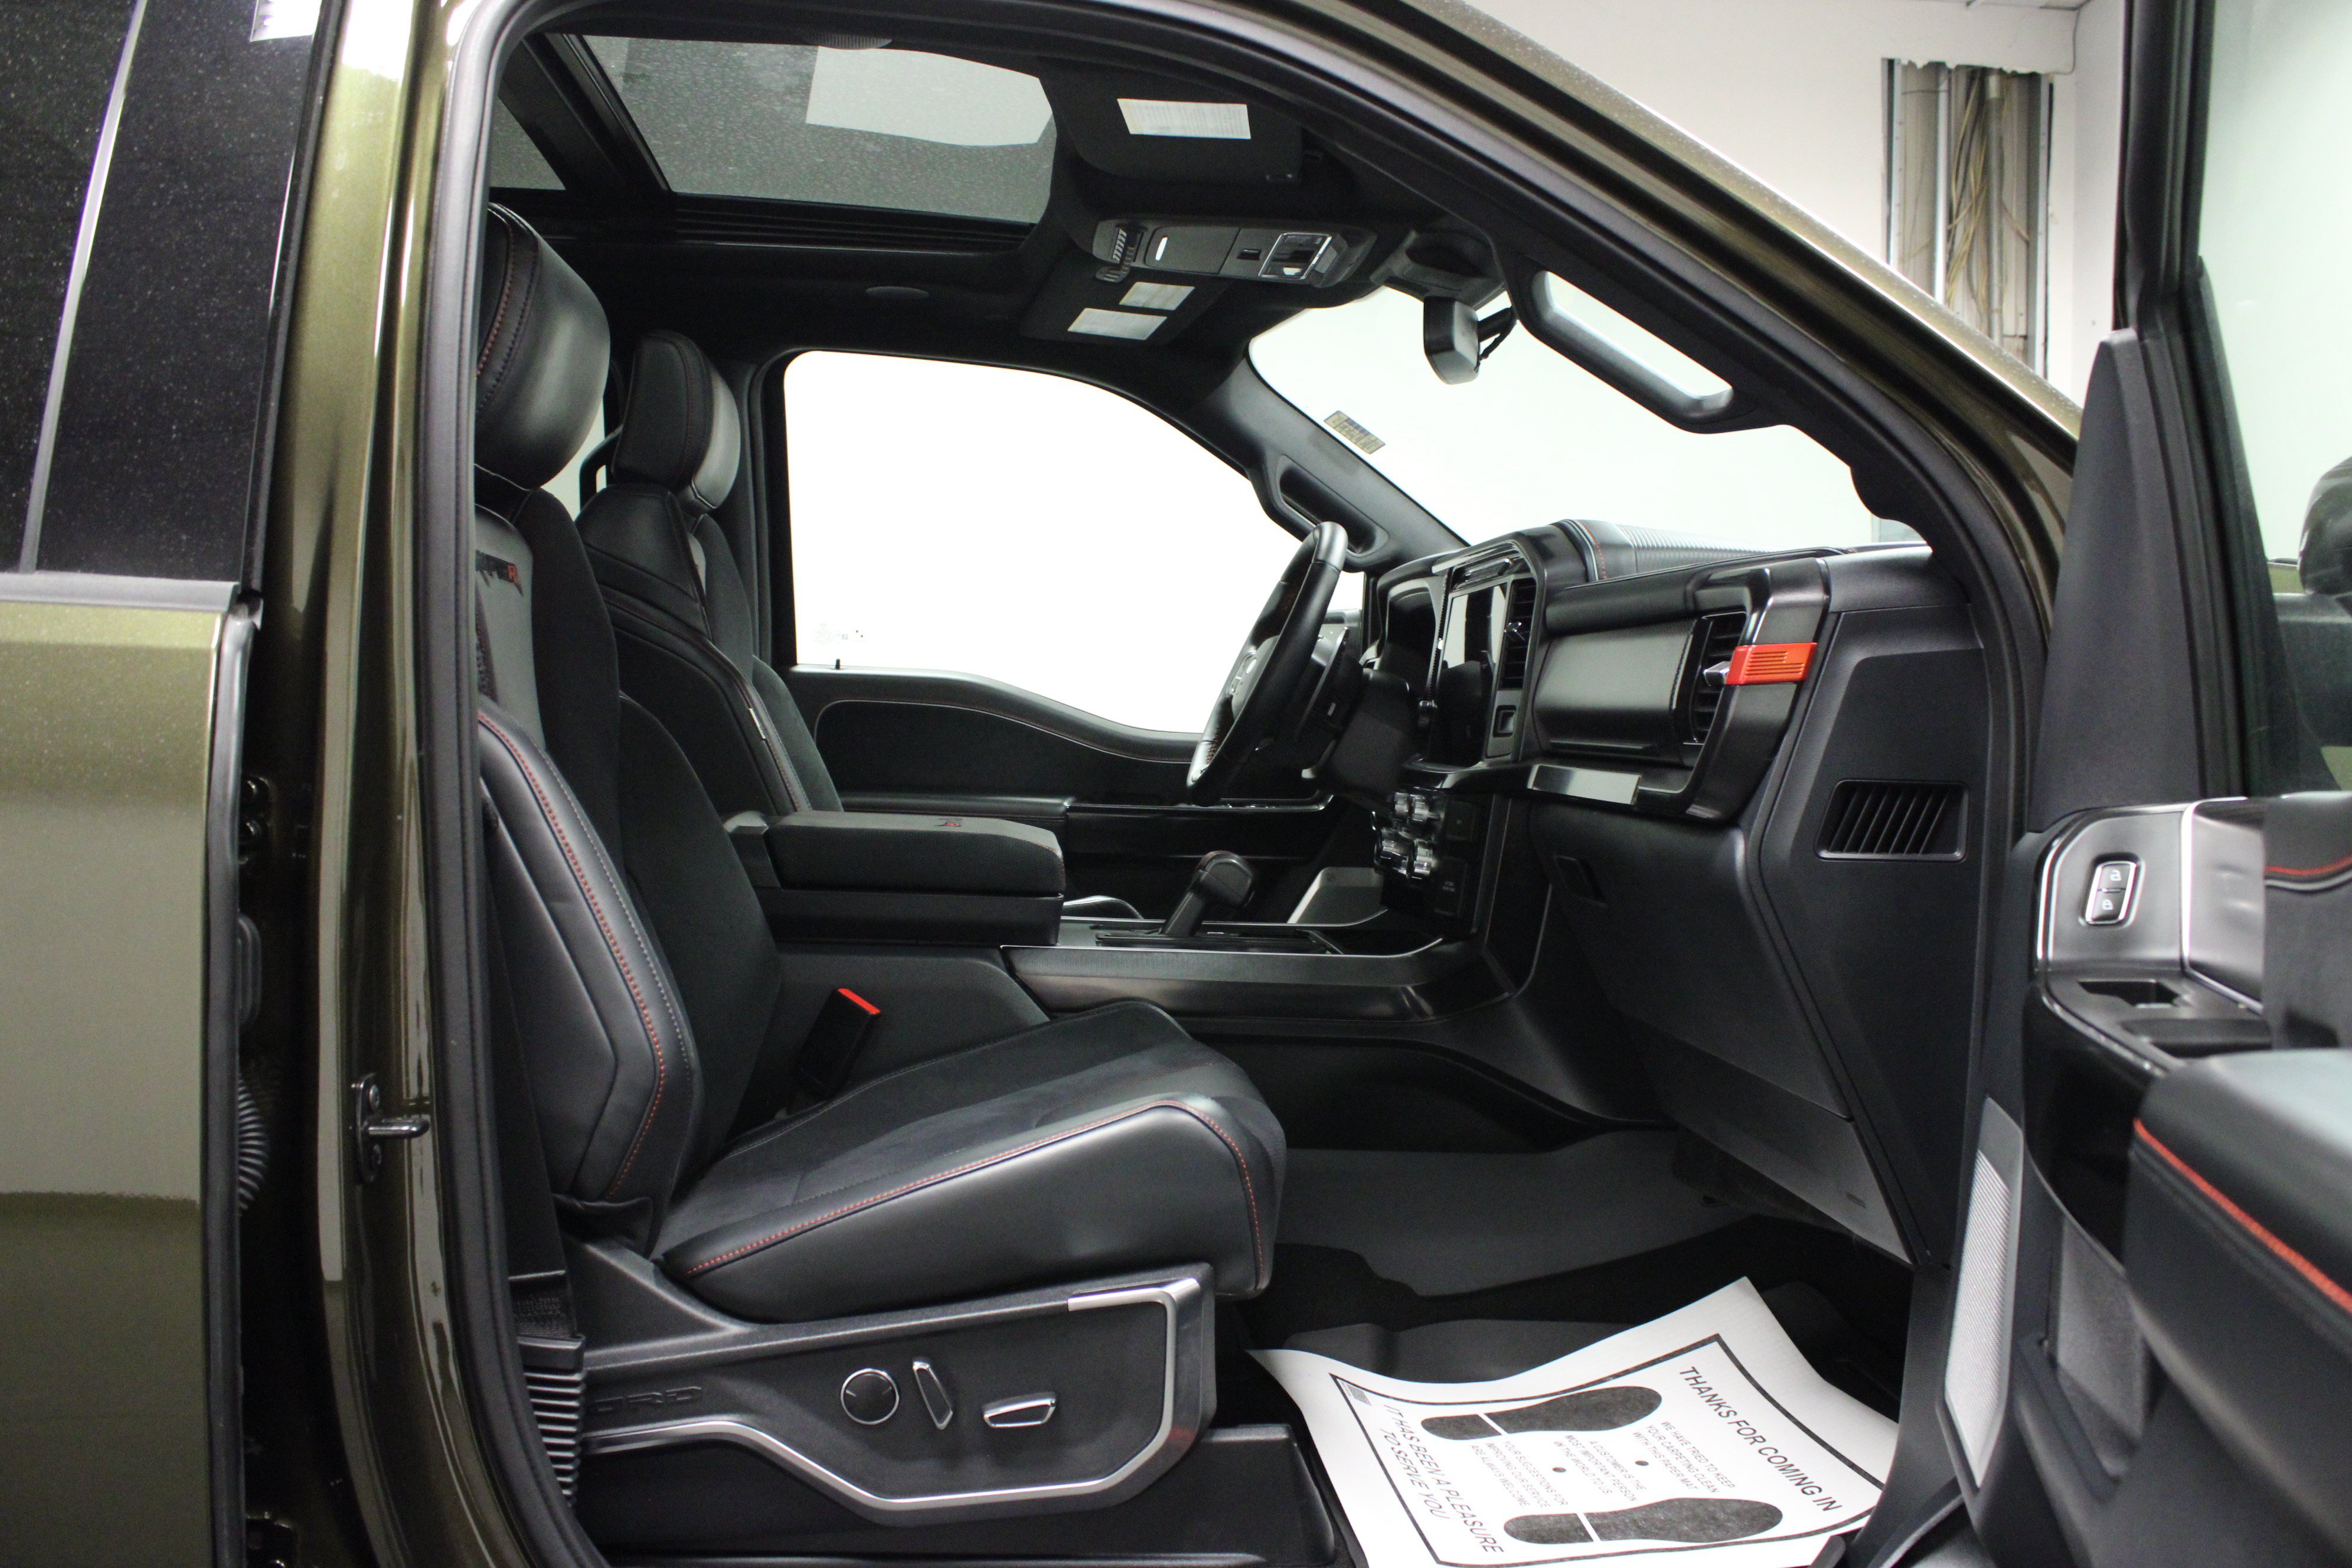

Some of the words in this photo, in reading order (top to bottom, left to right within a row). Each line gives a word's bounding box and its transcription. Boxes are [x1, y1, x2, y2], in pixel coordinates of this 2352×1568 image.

[589, 1386, 702, 1415] ORD
[1383, 1404, 1403, 1417] IT
[1391, 1417, 1419, 1441] HAS
[1409, 1444, 1444, 1475] BEEN
[1470, 1445, 1485, 1455] ARE
[1479, 1456, 1504, 1477] ALWAYS
[1560, 1448, 1576, 1457] THE
[1570, 1458, 1595, 1476] WORLD
[1564, 1435, 1585, 1448] MOST
[1579, 1449, 1615, 1477] IMPORTANT
[1610, 1479, 1638, 1501] PERSON
[1593, 1445, 1627, 1473] CUSTOMER
[1629, 1480, 1646, 1490] THE
[1632, 1432, 1652, 1445] WITH
[1646, 1446, 1665, 1458] THIS
[1659, 1459, 1684, 1477] PAPER
[1678, 1478, 1697, 1489] MAT
[1644, 1425, 1667, 1441] YOUR
[1660, 1441, 1699, 1472] CARPETING
[1693, 1473, 1720, 1493] CLEAN
[1660, 1420, 1676, 1431] WE
[1670, 1431, 1692, 1446] HAVE
[1685, 1446, 1709, 1463] TRIED
[1703, 1463, 1719, 1472] TO
[1712, 1472, 1736, 1488] KEEP
[1679, 1366, 1739, 1418] THANKS
[1726, 1419, 1768, 1445] FOR
[1755, 1446, 1825, 1495] COMING
[1812, 1497, 1843, 1511] IN
[1379, 1428, 1400, 1445] TO
[1390, 1447, 1429, 1489] SERVE
[1418, 1493, 1449, 1518] YOU
[1485, 1442, 1516, 1470] IMPROVING
[1511, 1471, 1528, 1483] OUR
[1523, 1484, 1550, 1507] SERVICE
[1502, 1440, 1521, 1455] YOUR
[1515, 1456, 1556, 1492] SUGGESTIONS
[1551, 1494, 1568, 1505] FOR
[1439, 1488, 1504, 1551] PLEASURE
